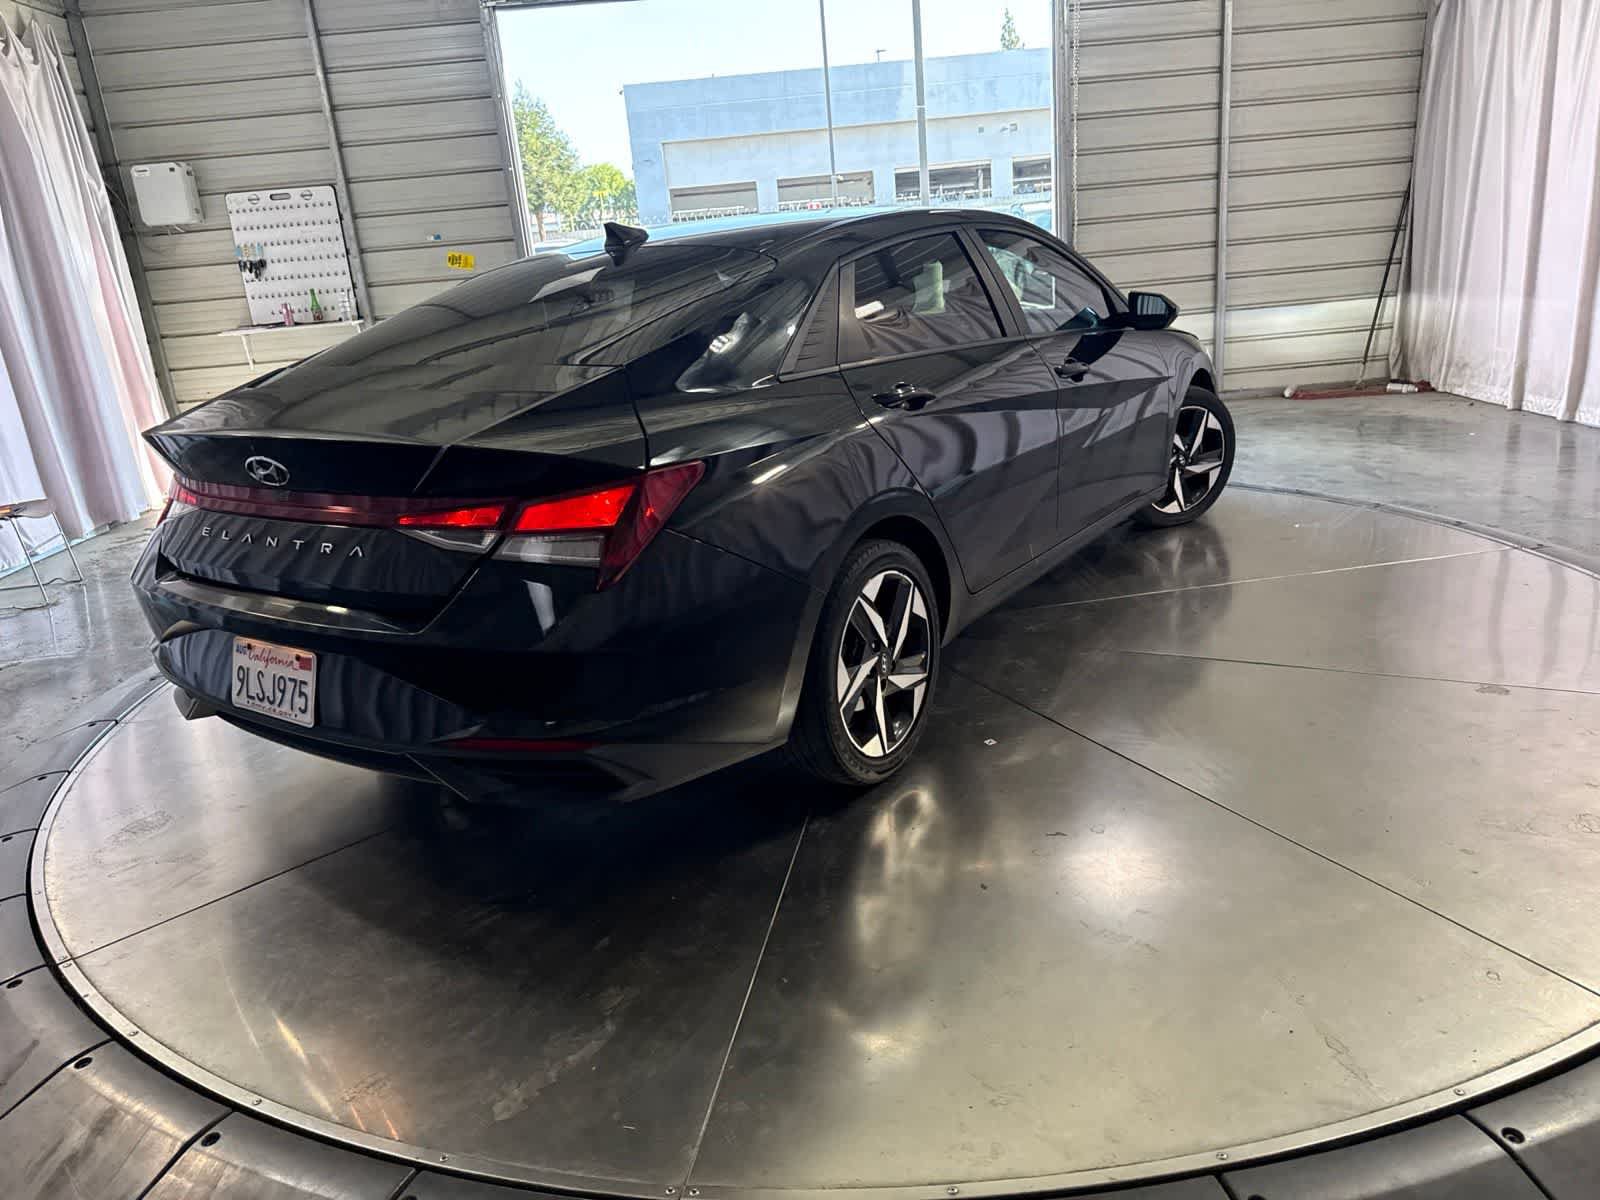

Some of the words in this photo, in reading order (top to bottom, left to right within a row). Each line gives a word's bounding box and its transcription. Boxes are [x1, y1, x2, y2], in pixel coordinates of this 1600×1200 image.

[201, 526, 363, 557] ELANTRA
[247, 645, 298, 671] California
[236, 664, 308, 714] 9LSJ975
